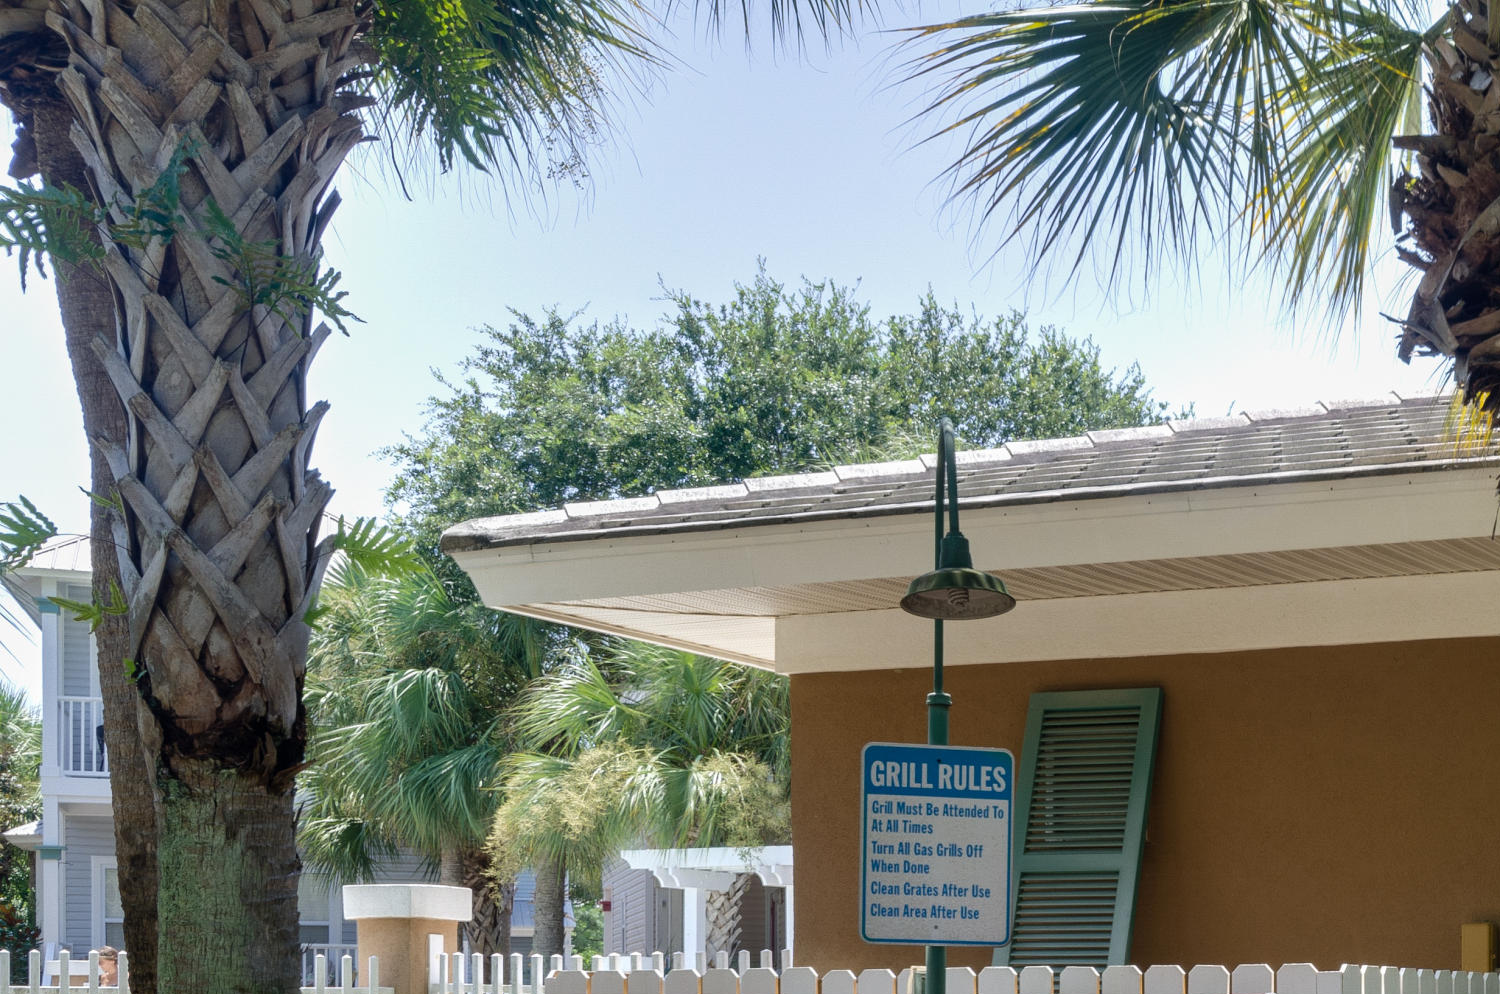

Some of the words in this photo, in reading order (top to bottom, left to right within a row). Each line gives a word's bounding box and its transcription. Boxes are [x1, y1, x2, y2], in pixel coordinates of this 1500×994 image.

[870, 760, 933, 788] GRILL
[938, 764, 1006, 792] RULES
[872, 801, 892, 814] Grill
[897, 802, 922, 816] Must
[926, 803, 939, 816] Be
[943, 804, 989, 818] Attended
[993, 806, 1004, 819] To
[872, 819, 883, 832] At
[886, 820, 898, 832] All
[903, 820, 933, 834] Times
[872, 841, 894, 854] Turn
[898, 842, 910, 855] All
[914, 843, 933, 856] Gas
[937, 843, 963, 857] Grills
[966, 844, 983, 858] Off
[871, 860, 899, 872] When
[904, 861, 929, 873] Done
[871, 882, 899, 895] Clean
[904, 882, 938, 896] Grates
[942, 884, 968, 897] After
[972, 885, 991, 898] Use
[870, 903, 899, 917] Clean
[903, 904, 927, 918] Area
[930, 905, 957, 918] After
[961, 906, 979, 919] Use
